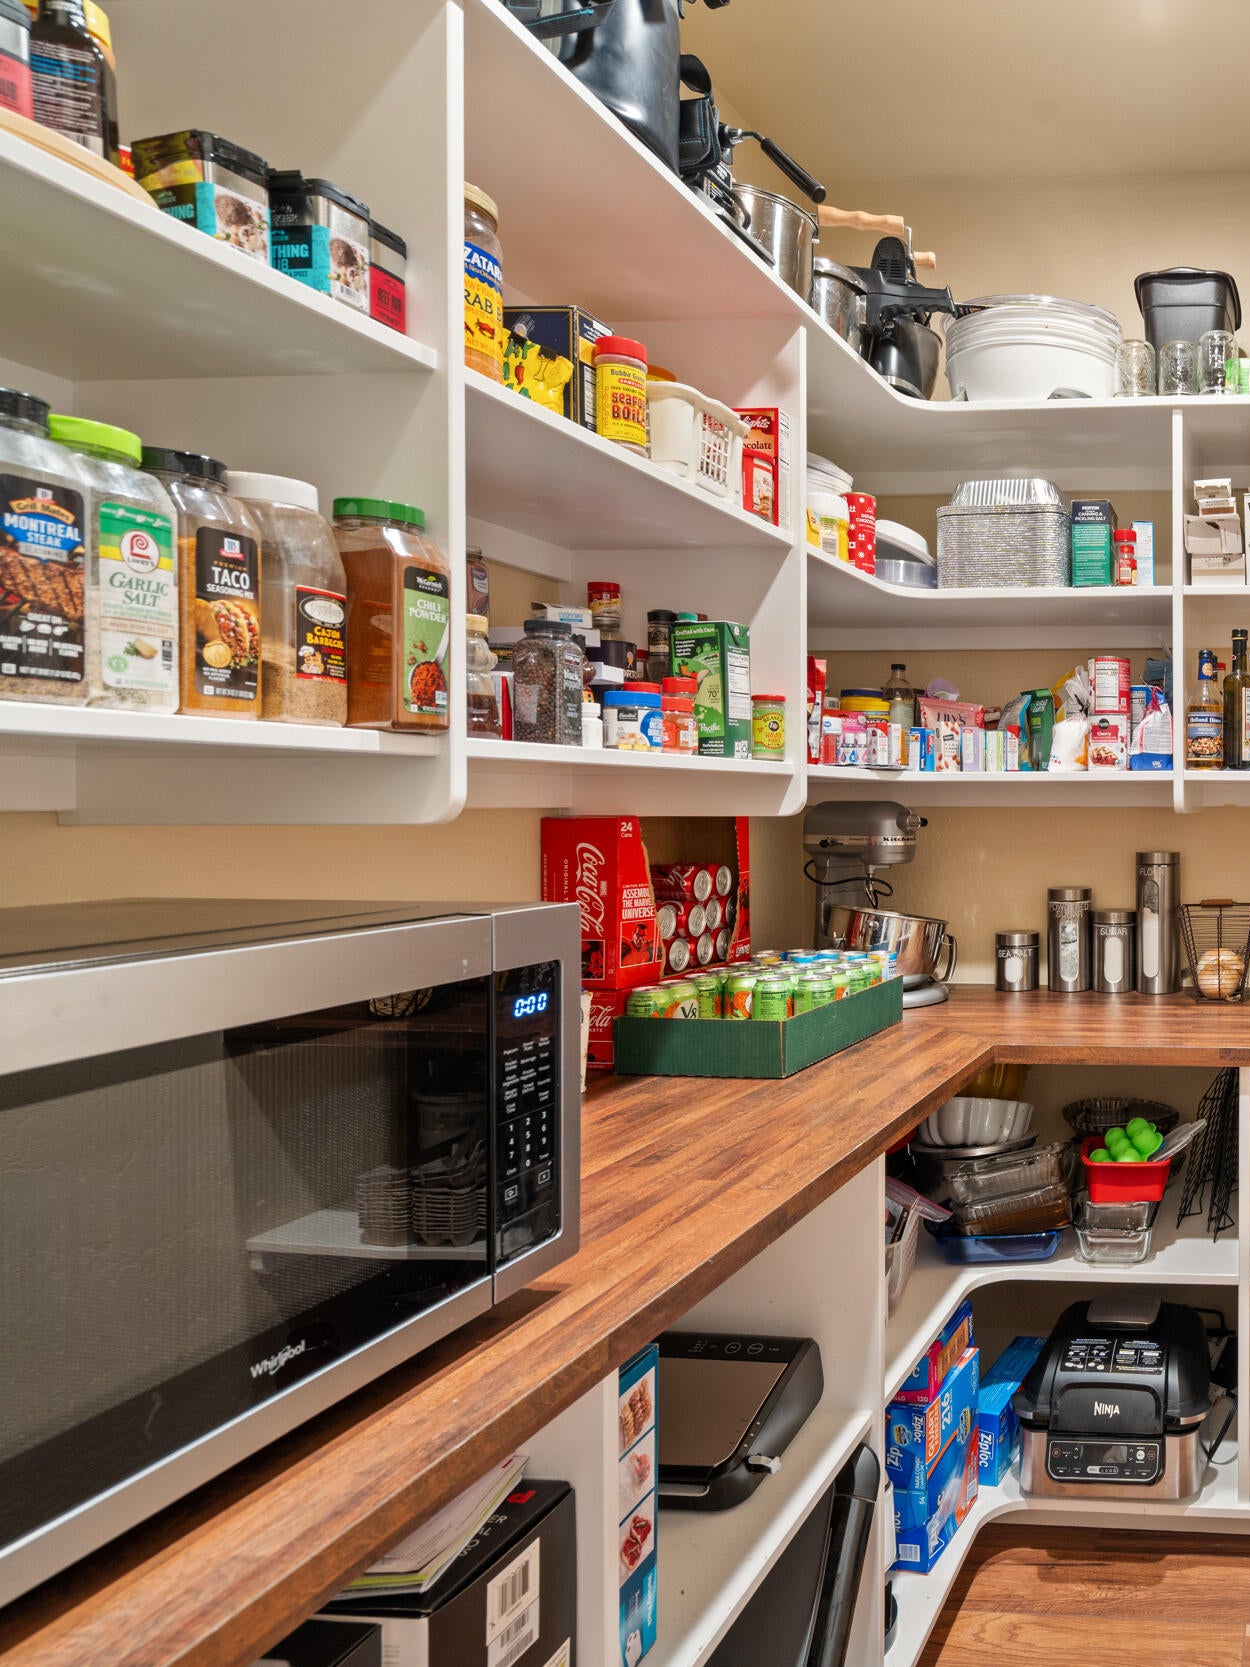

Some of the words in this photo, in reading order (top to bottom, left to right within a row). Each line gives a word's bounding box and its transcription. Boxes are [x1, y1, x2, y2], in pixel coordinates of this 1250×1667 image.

[611, 369, 630, 379] Bubba
[3, 512, 82, 542] MONTREAL
[26, 531, 62, 548] STEAK
[108, 572, 169, 596] GARLIC
[211, 567, 250, 589] TACO
[206, 583, 241, 597] SEASONING
[121, 591, 160, 608] SALT
[416, 599, 442, 611] CHILI
[409, 608, 447, 623] POWDER
[313, 626, 341, 638] CAJUN
[699, 722, 721, 732] Pacific
[620, 822, 633, 832] 24
[622, 899, 633, 909] THE
[622, 906, 655, 919] UNIVERSE
[1056, 910, 1083, 918] SUGAR
[1100, 927, 1128, 936] SUGAR
[998, 949, 1011, 958] SEA
[514, 993, 548, 1017] 0:00
[681, 1002, 697, 1019] V8
[542, 1111, 546, 1119] 3
[526, 1118, 530, 1126] 2
[542, 1124, 546, 1132] 6
[526, 1131, 530, 1139] 5
[542, 1137, 546, 1145] 9
[509, 1151, 514, 1159] 7
[526, 1159, 531, 1167] 0
[250, 1339, 306, 1378] Whirlpool
[941, 1391, 950, 1430] 216
[1093, 1401, 1120, 1419] NINJA
[912, 1415, 924, 1444] Ziploc
[927, 1410, 935, 1457] QUART
[978, 1433, 992, 1468] Ziploc
